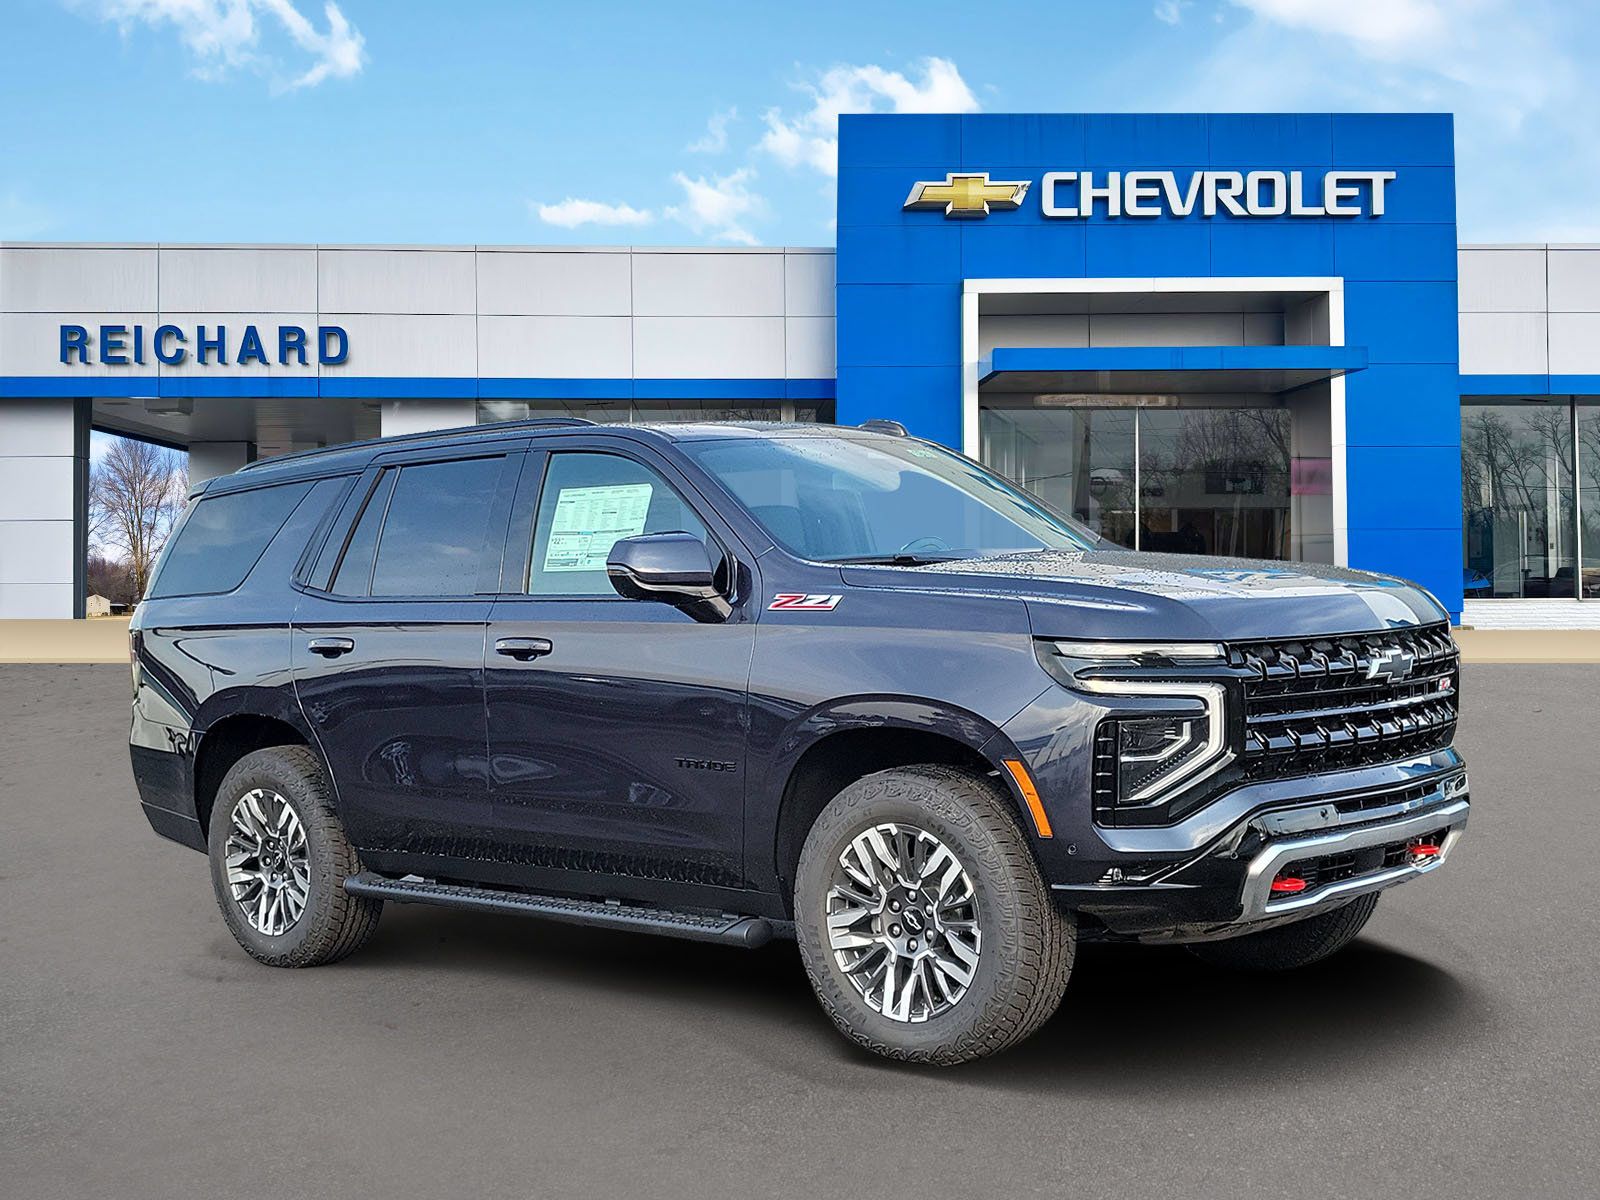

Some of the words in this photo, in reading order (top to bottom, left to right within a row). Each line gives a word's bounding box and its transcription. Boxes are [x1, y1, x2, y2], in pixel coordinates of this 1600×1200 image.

[1042, 171, 1396, 216] CHEVROLET
[59, 324, 350, 366] REICHARD
[768, 593, 844, 611] Z71
[674, 757, 737, 773] TAHOE
